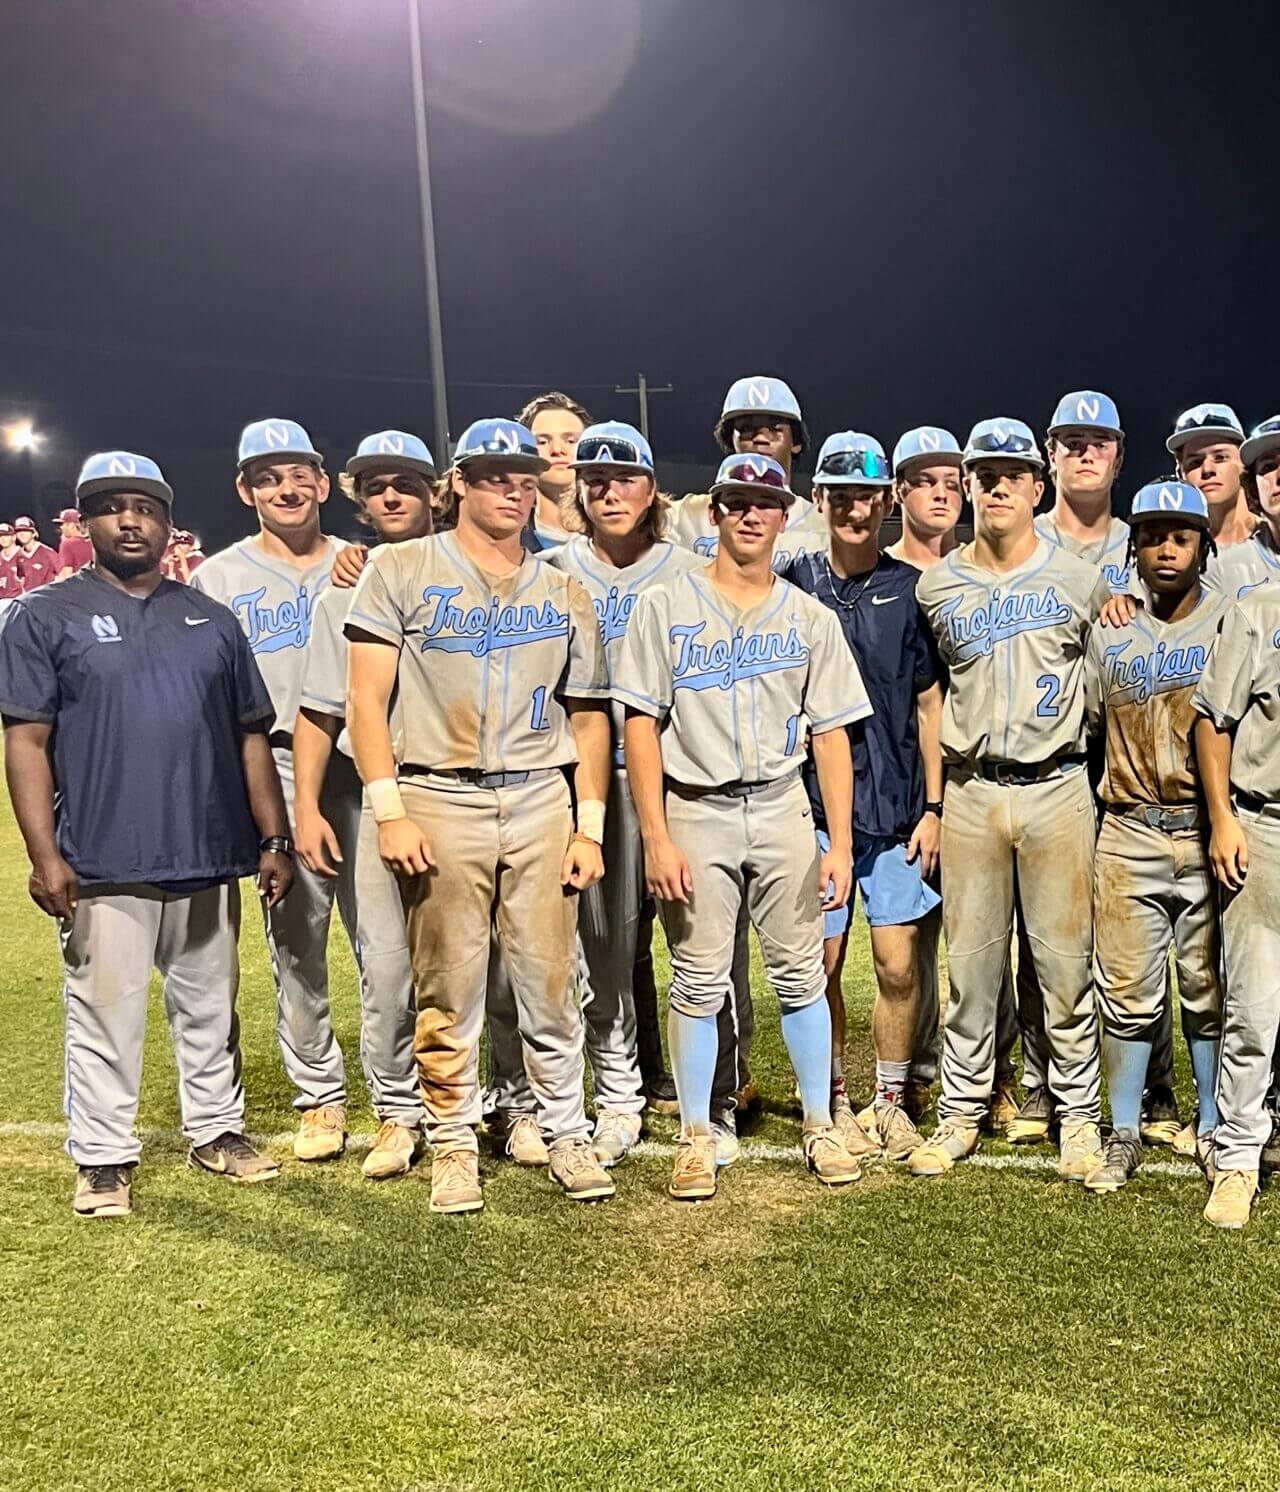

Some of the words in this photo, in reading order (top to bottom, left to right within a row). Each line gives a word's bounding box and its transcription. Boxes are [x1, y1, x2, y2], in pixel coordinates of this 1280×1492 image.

[748, 384, 770, 406] N
[1077, 400, 1099, 421] N
[265, 425, 289, 447] N
[379, 434, 404, 456] N
[919, 431, 941, 451] N
[109, 458, 136, 476] N
[1158, 487, 1184, 511] N
[91, 614, 119, 637] N
[422, 585, 569, 658] Trojans
[937, 587, 1072, 661] Trojans
[669, 621, 810, 691] Trojans
[1102, 639, 1215, 706] Trojan
[530, 685, 551, 730] 1
[1036, 675, 1060, 718] 2
[784, 715, 800, 756] 1
